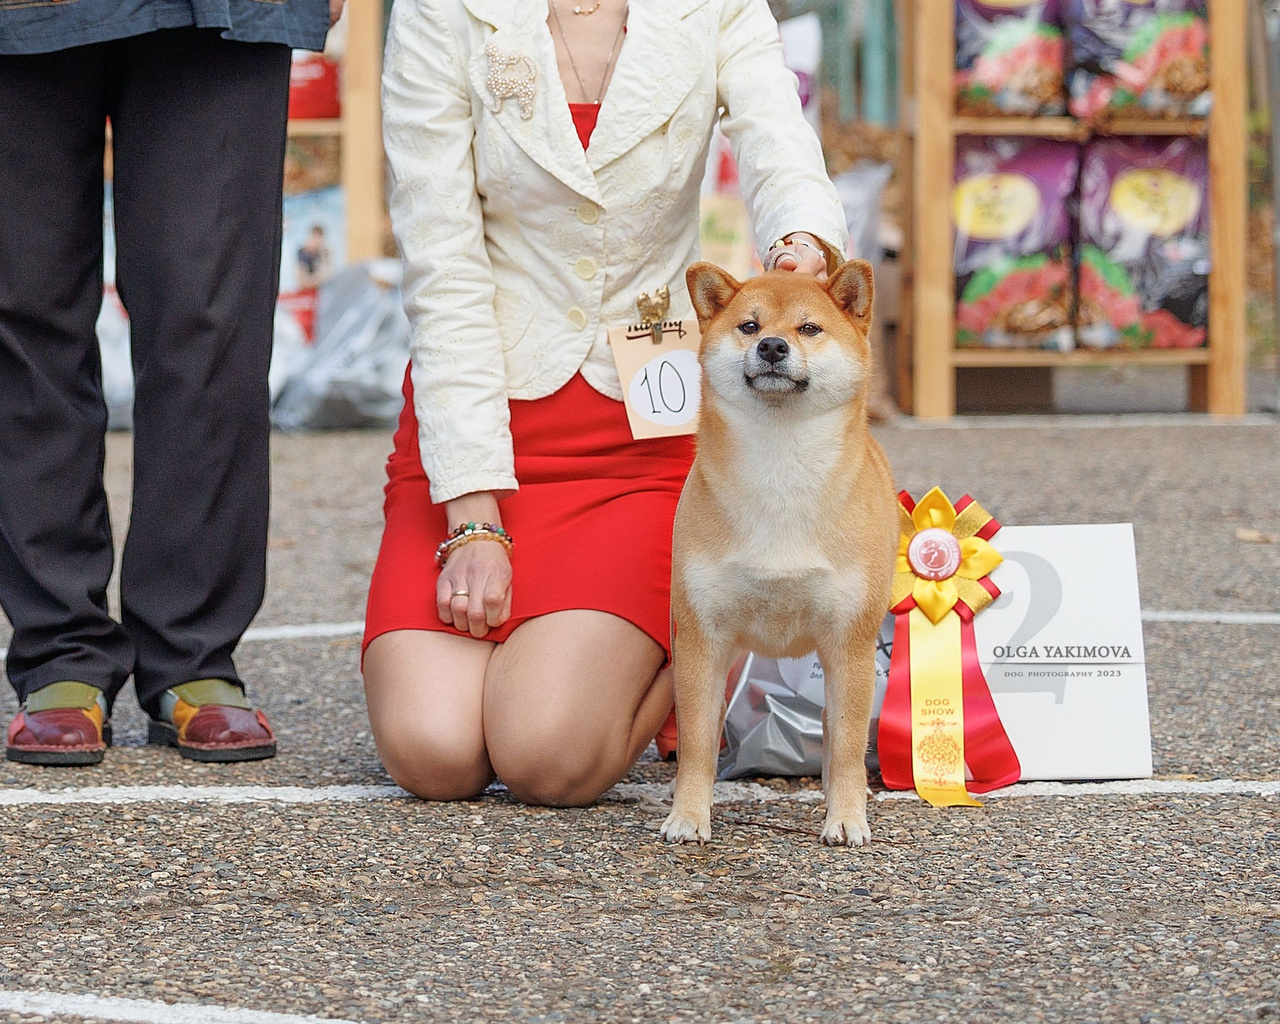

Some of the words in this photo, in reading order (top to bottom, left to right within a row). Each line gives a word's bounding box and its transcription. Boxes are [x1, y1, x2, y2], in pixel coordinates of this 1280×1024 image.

[640, 360, 686, 414] 10
[987, 550, 1068, 705] 2
[993, 646, 1040, 658] OLGA
[1043, 646, 1132, 658] YAKIMOVA
[1097, 670, 1122, 678] 2023
[925, 698, 950, 707] DOG
[921, 708, 955, 716] SHOW
